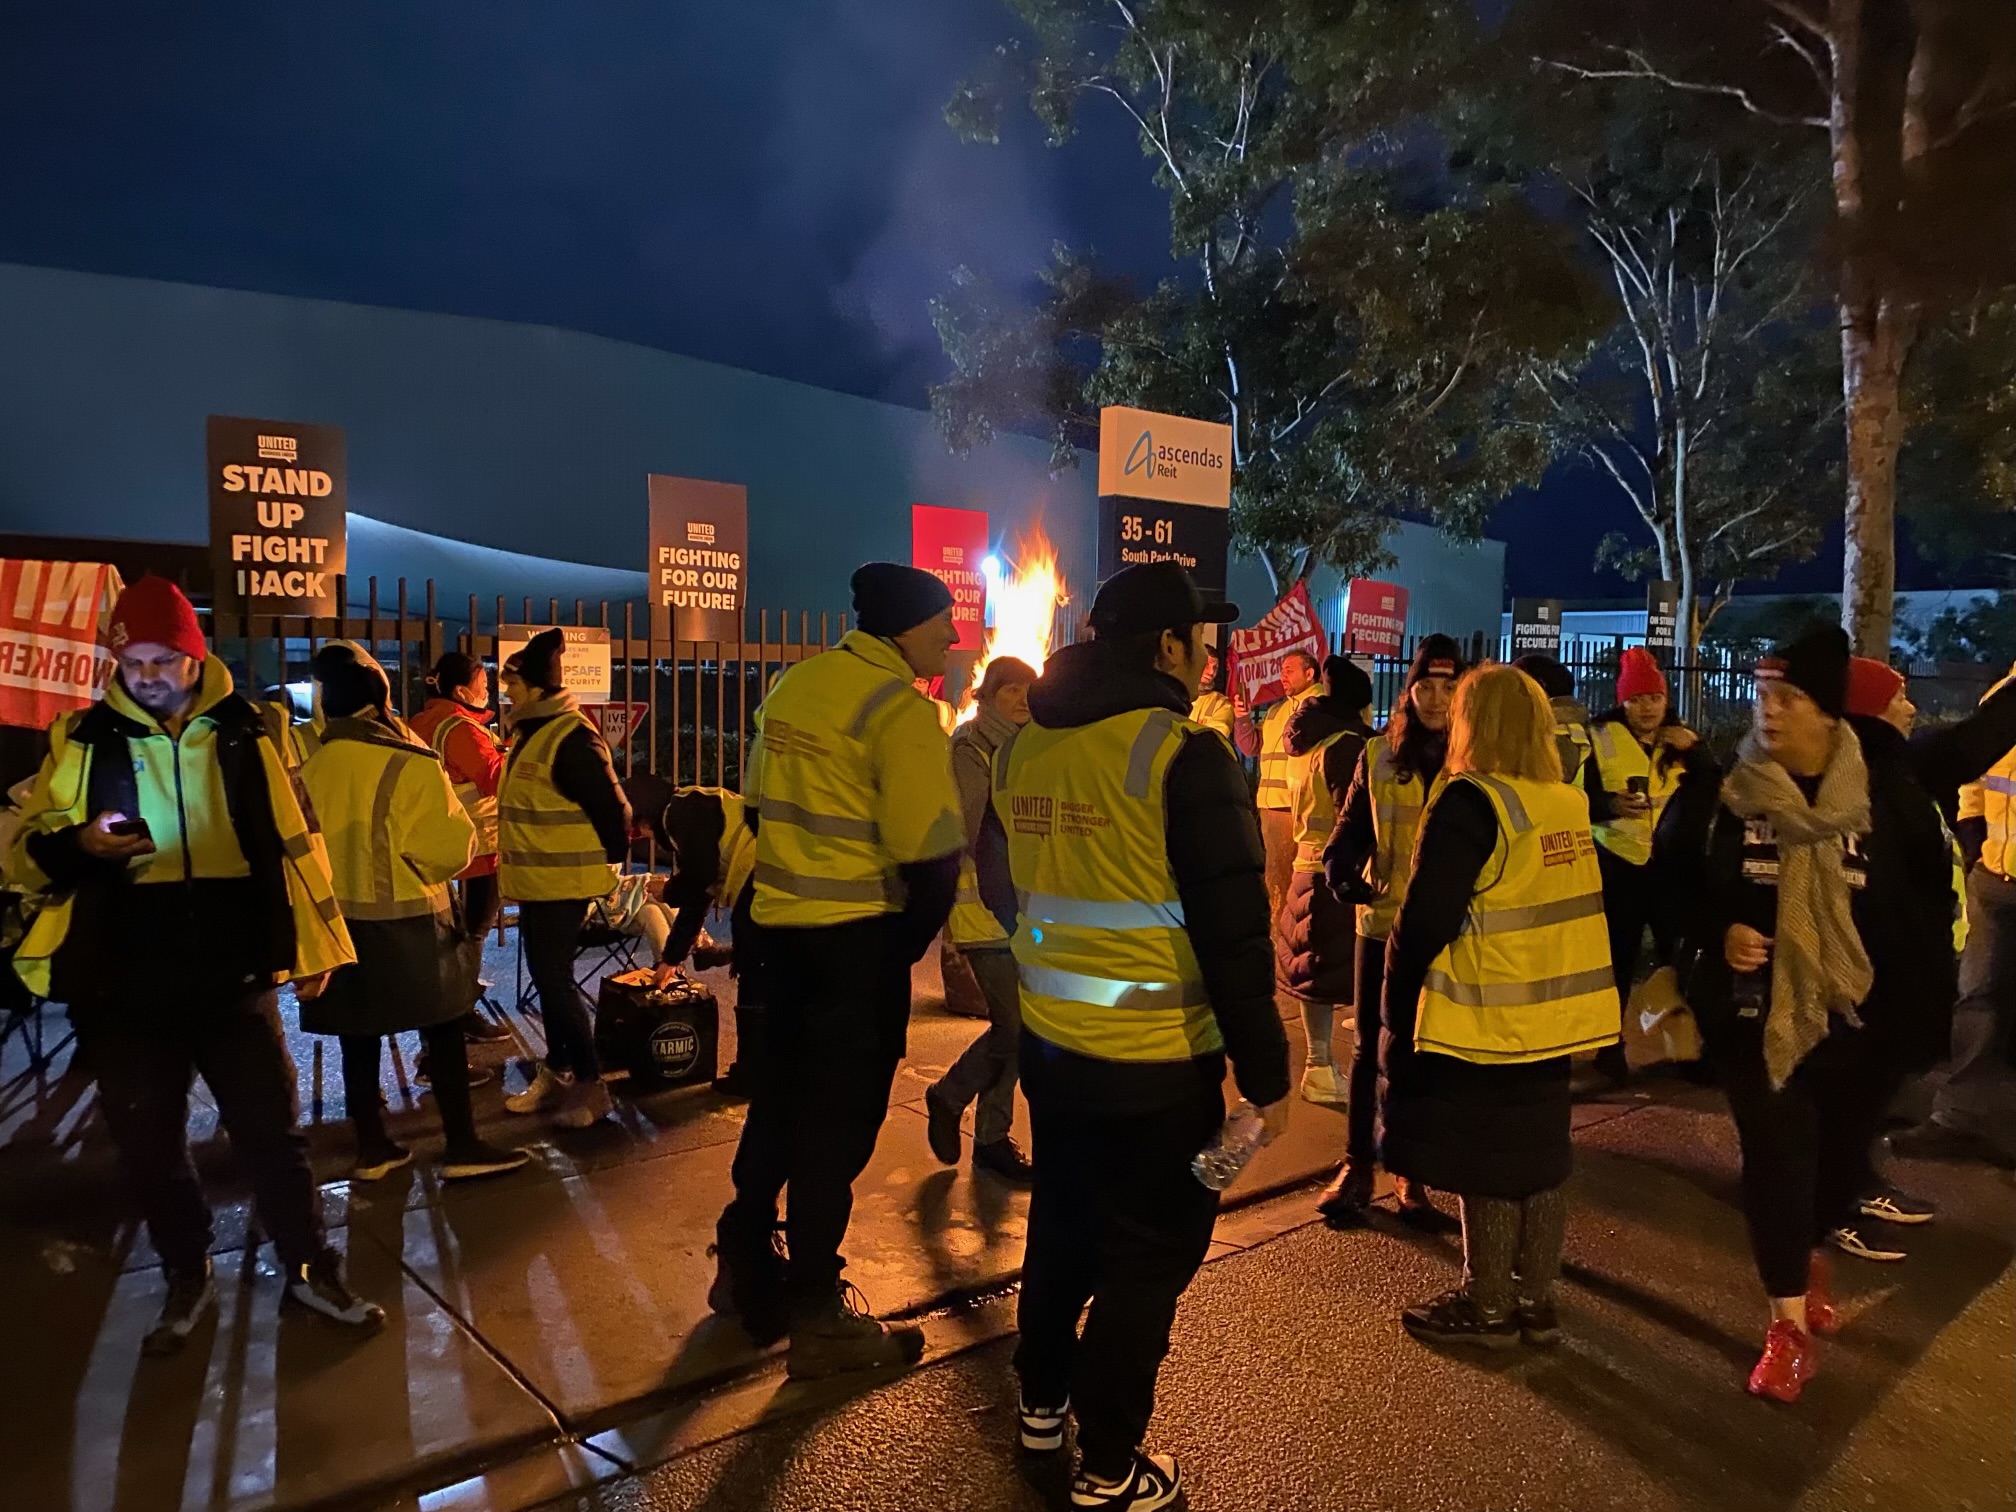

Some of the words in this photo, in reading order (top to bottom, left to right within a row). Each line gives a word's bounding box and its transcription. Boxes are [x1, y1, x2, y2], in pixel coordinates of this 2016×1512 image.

[258, 435, 297, 450] UNITED
[1158, 445, 1223, 469] ascendas
[222, 464, 333, 497] STAND
[1157, 464, 1177, 479] Reit
[257, 501, 304, 528] UP
[687, 522, 715, 536] UNITED
[232, 534, 328, 564] FIGHT
[1122, 547, 1149, 563] South
[659, 547, 740, 570] FIGHTING
[237, 569, 326, 598] BACK
[661, 568, 699, 587] FOR
[702, 571, 737, 590] OUR
[922, 567, 983, 586] GHTING
[662, 590, 736, 611] FUTURE!
[954, 588, 981, 604] OUR
[951, 606, 979, 622] URE!
[1352, 628, 1392, 644] SECURE
[1515, 623, 1550, 635] FIGHTING
[563, 665, 602, 677] PSAFE
[608, 713, 627, 723] IVE
[1012, 795, 1053, 818] UNITED
[1060, 824, 1092, 837] UNITED
[1540, 830, 1573, 853] UNITED
[652, 1038, 694, 1056] KARMIC
